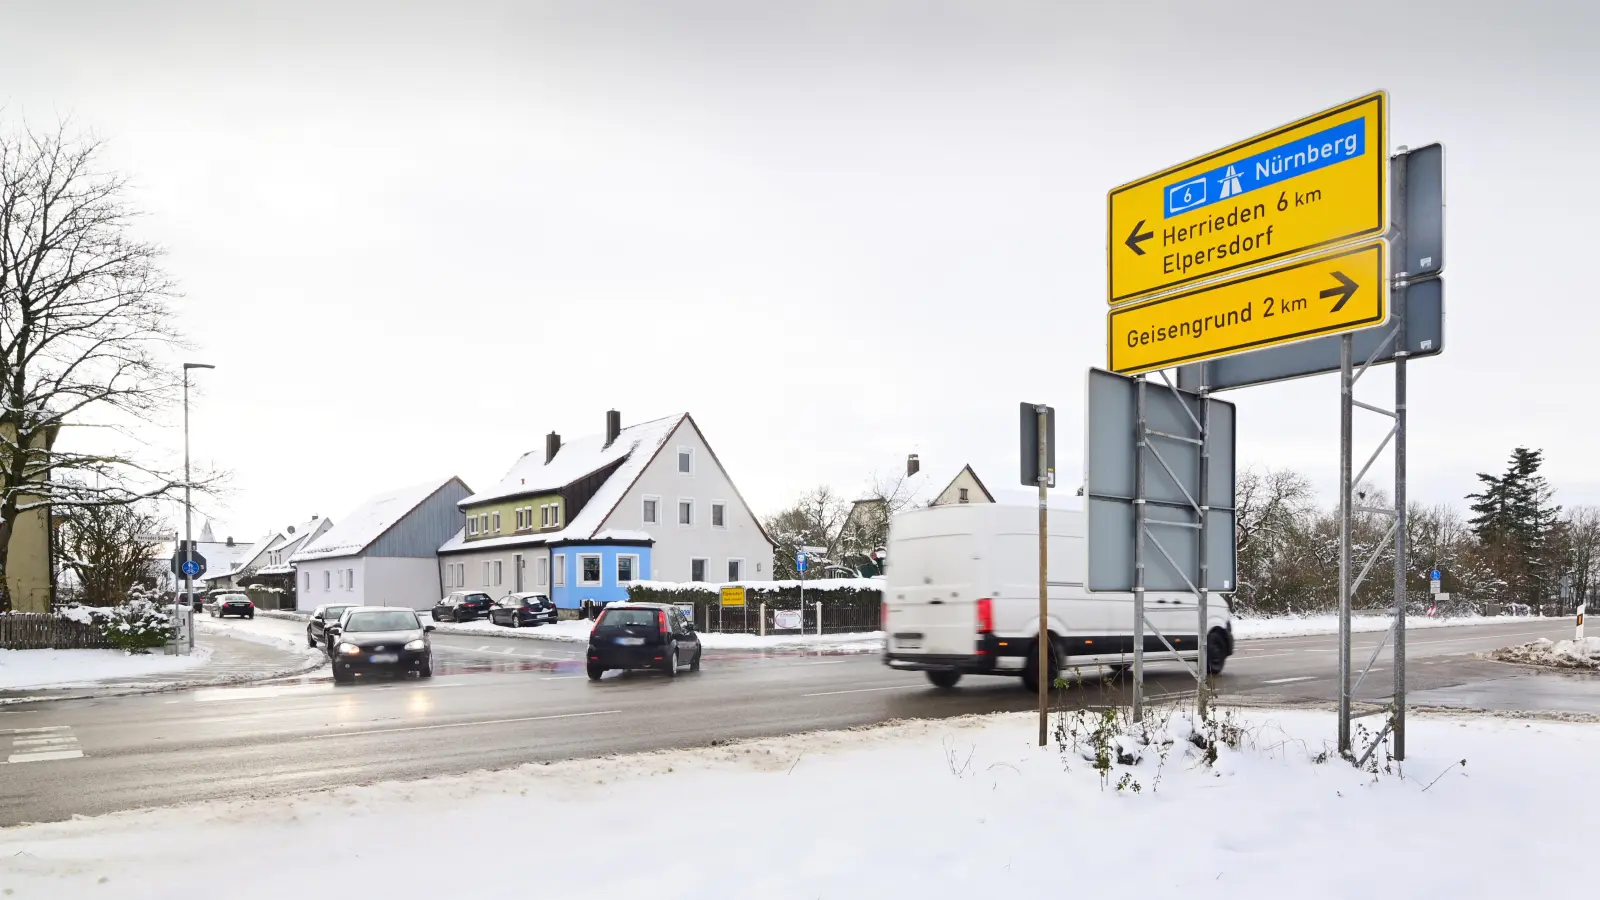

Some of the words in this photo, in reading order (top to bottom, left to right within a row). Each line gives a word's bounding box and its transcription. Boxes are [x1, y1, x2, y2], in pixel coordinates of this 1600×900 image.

[1256, 133, 1358, 181] Nürnberg
[1163, 203, 1266, 247] Herrieden
[1277, 191, 1289, 212] 6
[1295, 187, 1322, 207] km
[1183, 187, 1193, 203] 6
[1163, 225, 1275, 275] Elpersdorf
[1127, 301, 1253, 348] Geisengrund
[1263, 297, 1275, 318] 2
[1281, 297, 1307, 314] km
